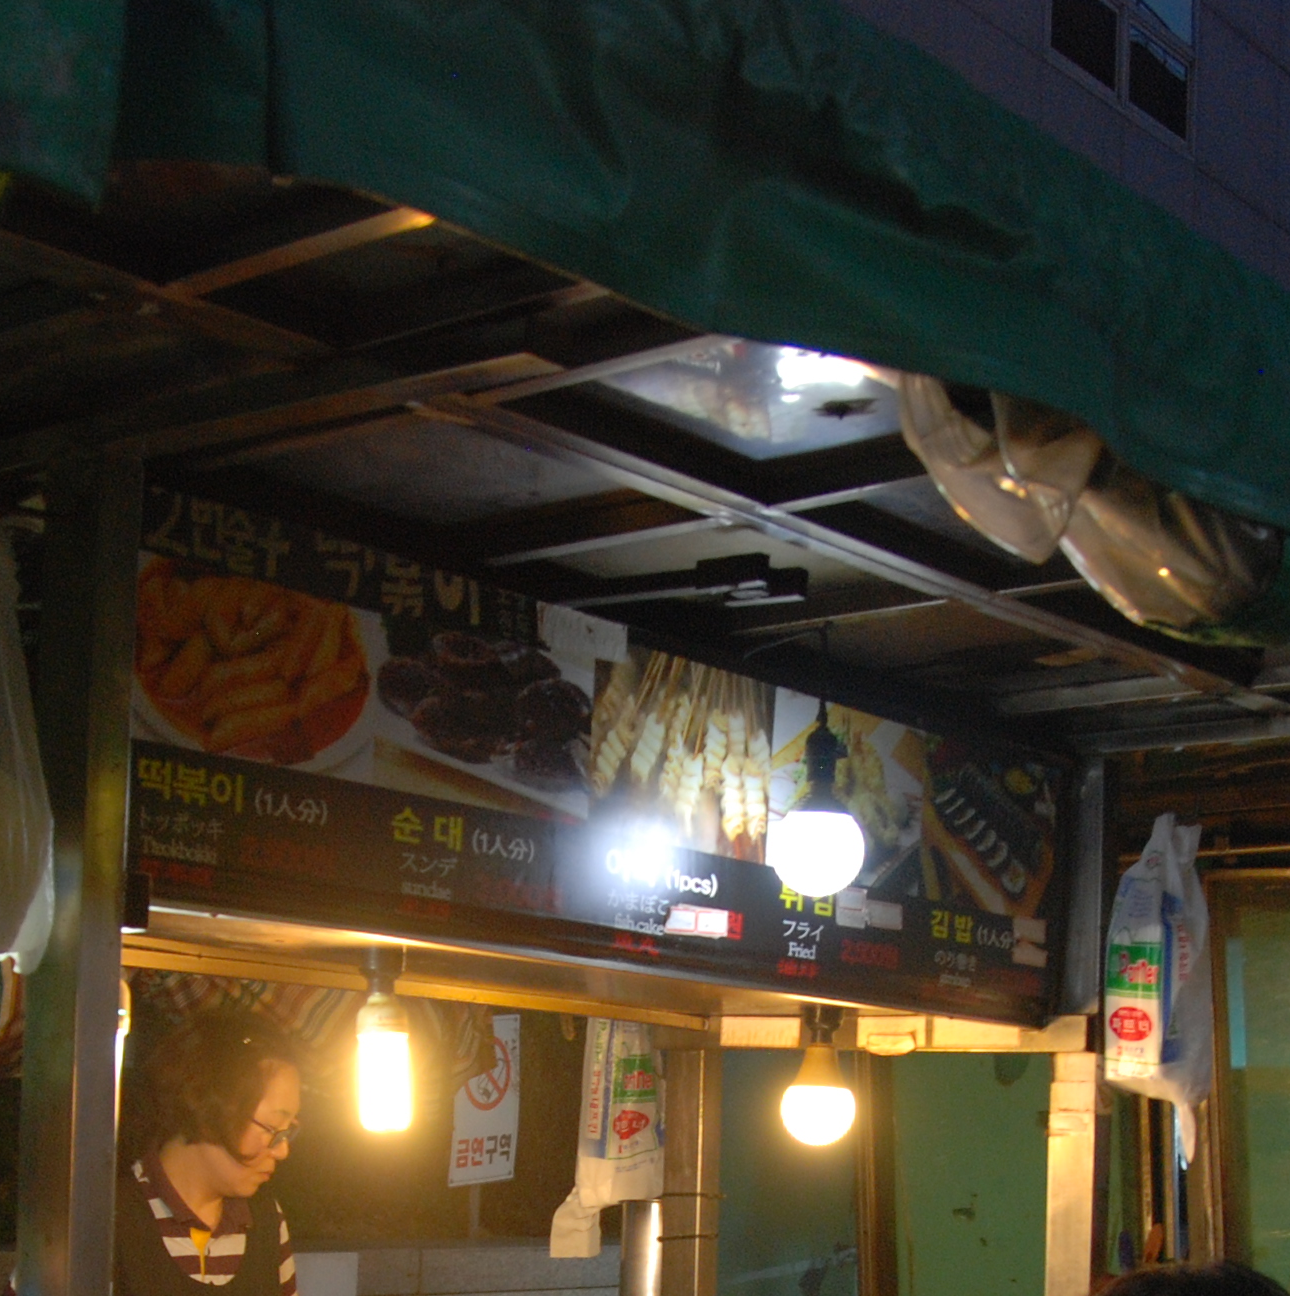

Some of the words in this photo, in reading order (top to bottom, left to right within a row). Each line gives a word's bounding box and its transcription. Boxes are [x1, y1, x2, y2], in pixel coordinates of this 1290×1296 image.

[138, 756, 245, 813] 떡볶이
[782, 919, 825, 942] フライ
[455, 1132, 512, 1169] 금연구역
